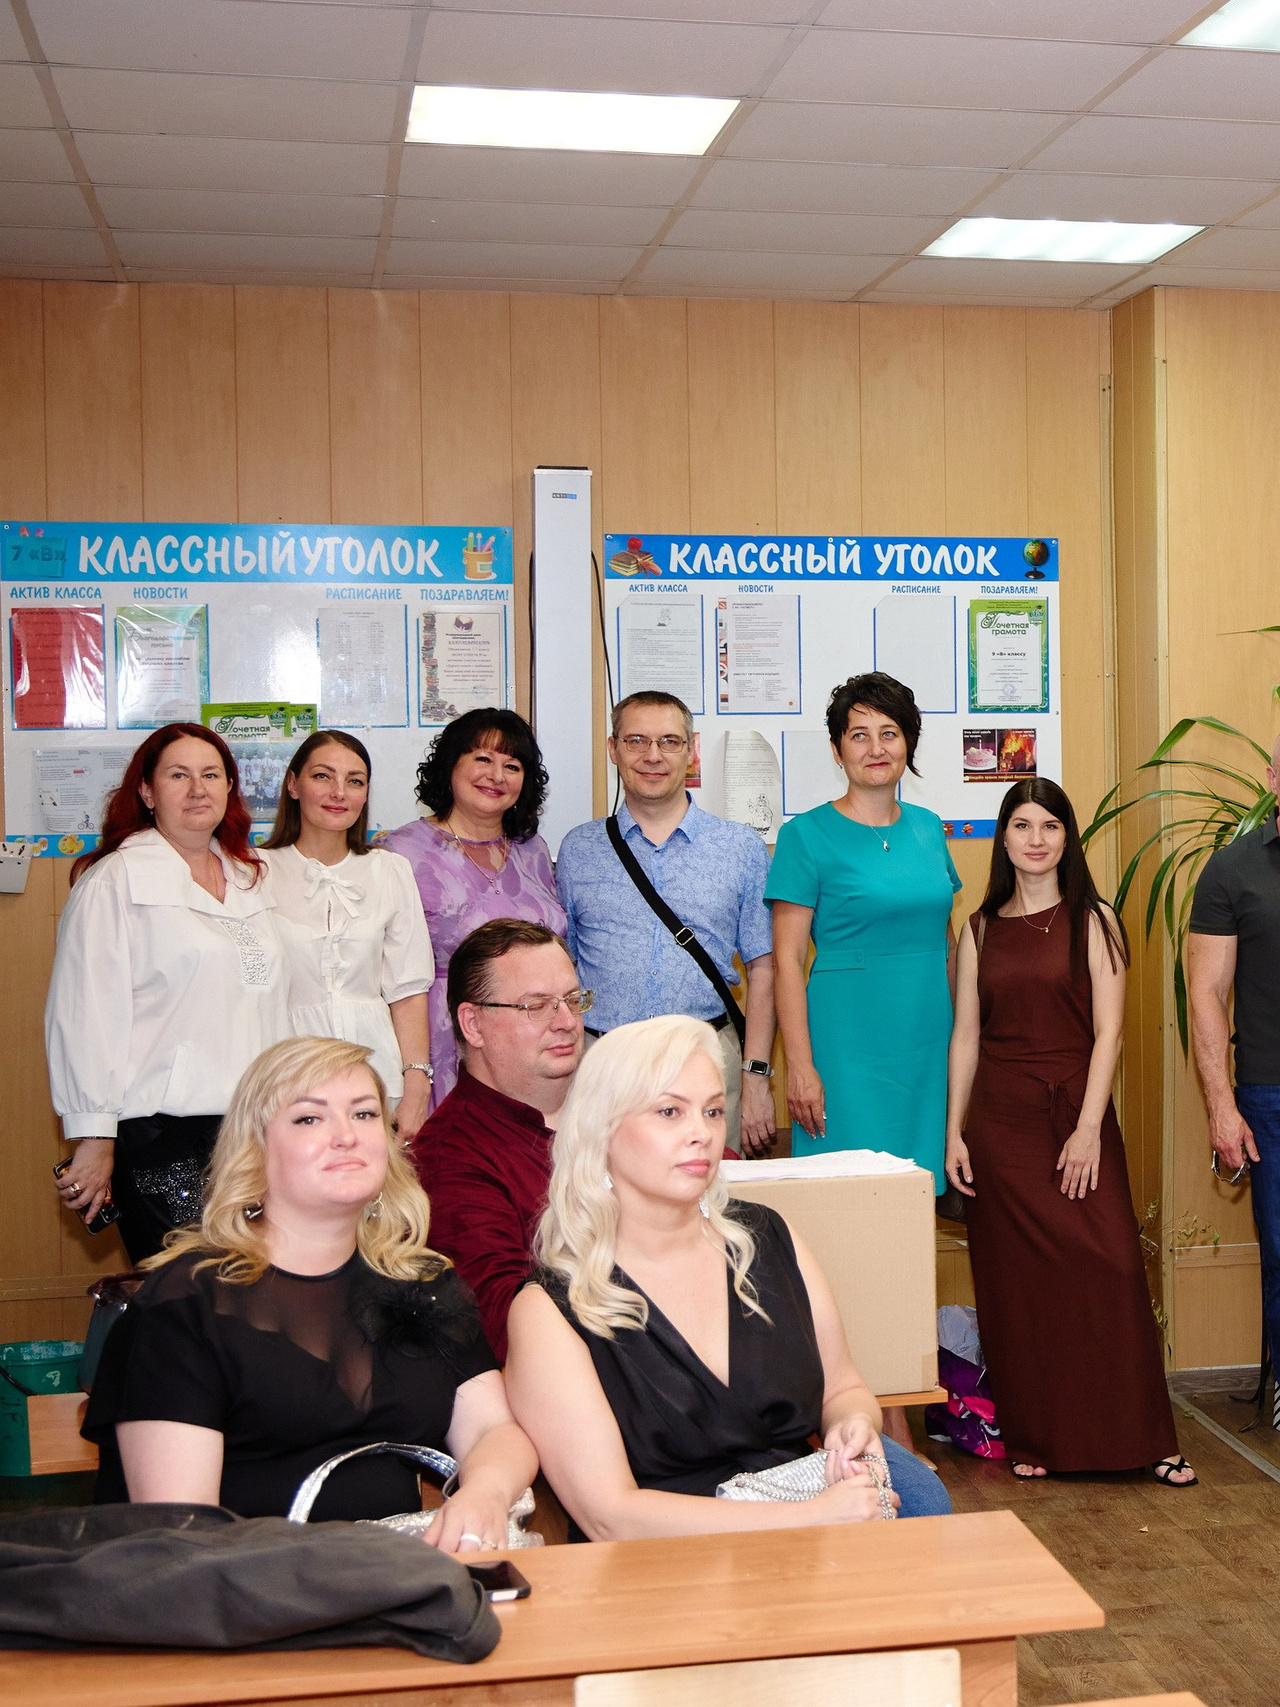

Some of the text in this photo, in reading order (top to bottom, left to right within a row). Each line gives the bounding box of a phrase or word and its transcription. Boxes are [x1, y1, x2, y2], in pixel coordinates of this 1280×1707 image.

[11, 545, 23, 561] 7
[79, 531, 443, 577] КЛАССНЫЙ УГОЛОК
[669, 537, 1000, 576] КЛАССНЫЙ УГОЛОК
[10, 586, 102, 599] АКТИВ КЛАССА
[133, 586, 188, 599] НОВОСТИ
[326, 588, 402, 600] РАСПИСАНИЕ
[420, 588, 509, 601] ПОЗДРАВЛЯЕМ!
[629, 584, 688, 593] АКТИВ КЛАССА
[738, 584, 774, 593] НОВОСТИ
[891, 585, 941, 594] РАСПИСАНИЕ
[981, 585, 1038, 594] ПОЗДРАВЛЯЕМ!
[981, 611, 1030, 629] Почетная
[215, 714, 271, 733] Почетная
